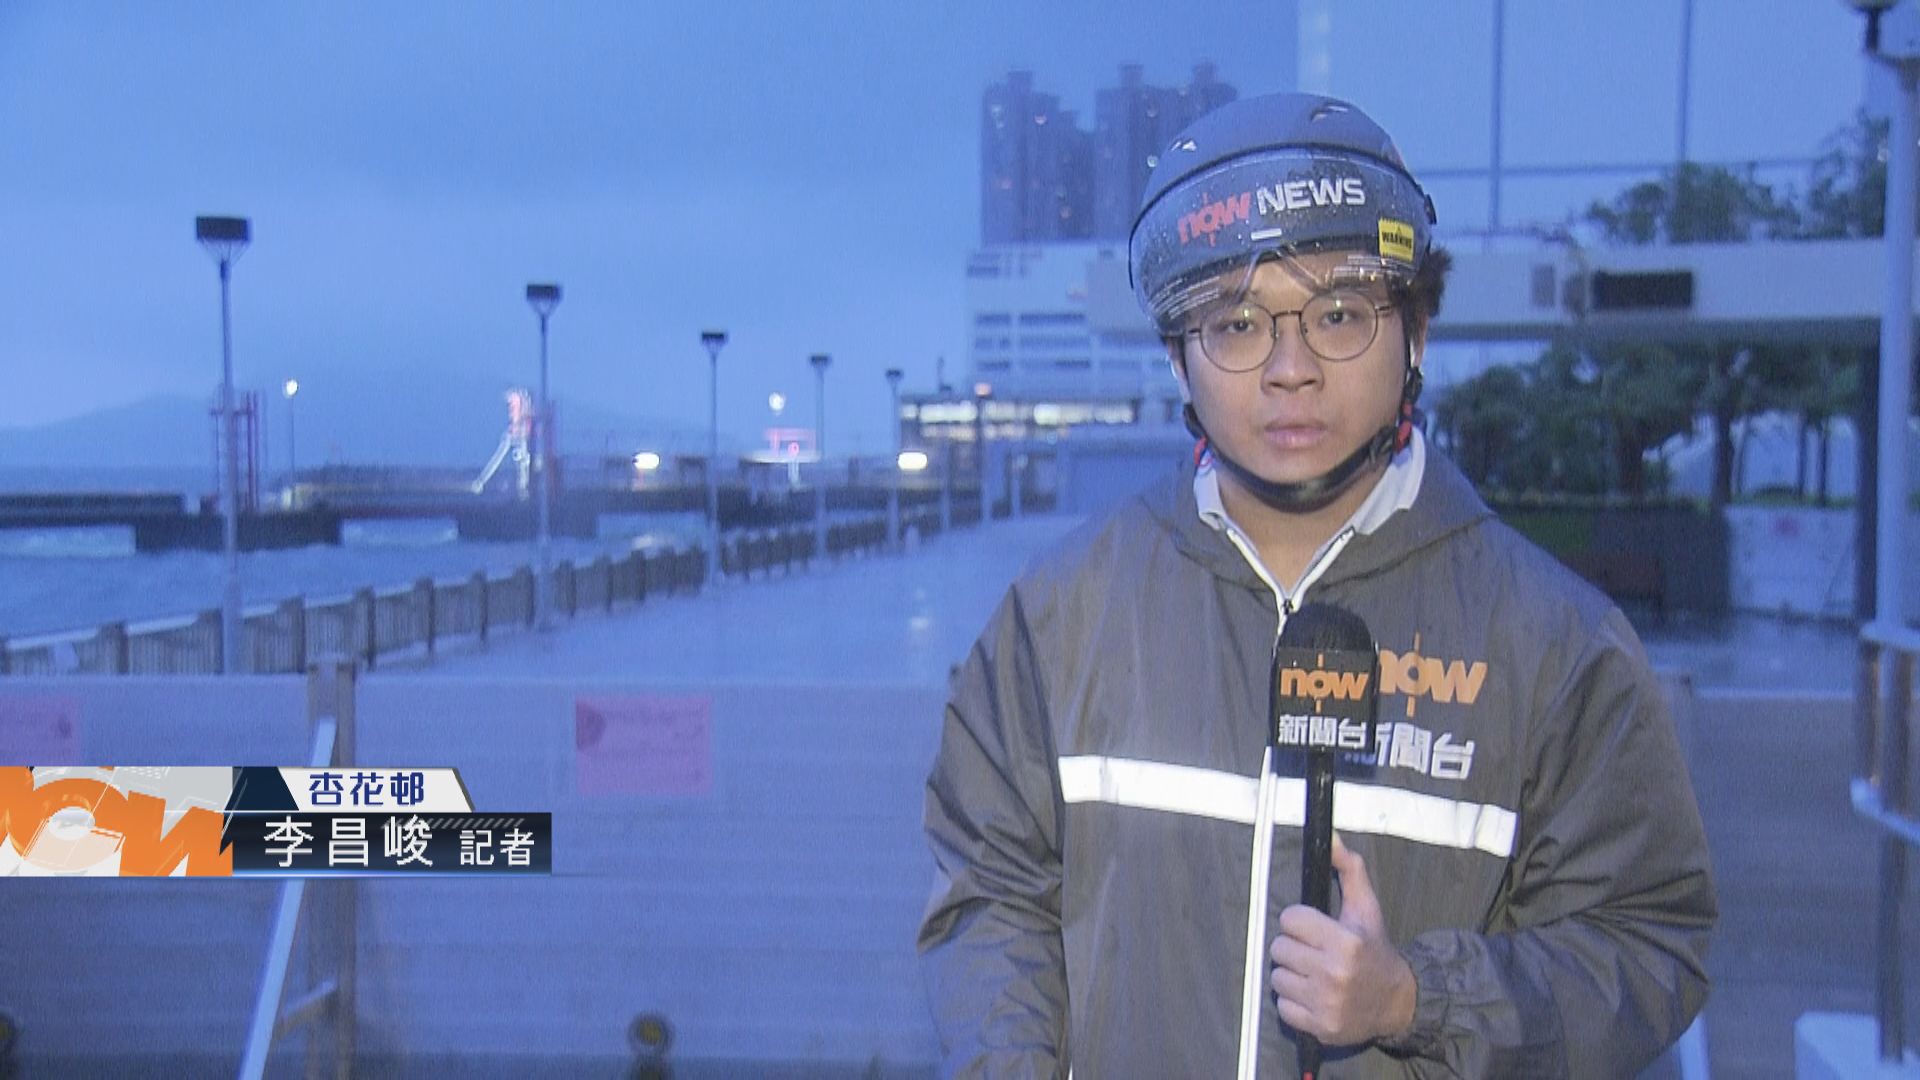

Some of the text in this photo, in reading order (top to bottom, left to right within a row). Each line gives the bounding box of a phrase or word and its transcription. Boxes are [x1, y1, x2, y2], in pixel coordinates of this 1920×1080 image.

[1178, 177, 1366, 247] now NEWS
[1279, 656, 1369, 711] now
[1278, 714, 1367, 749] 新聞台
